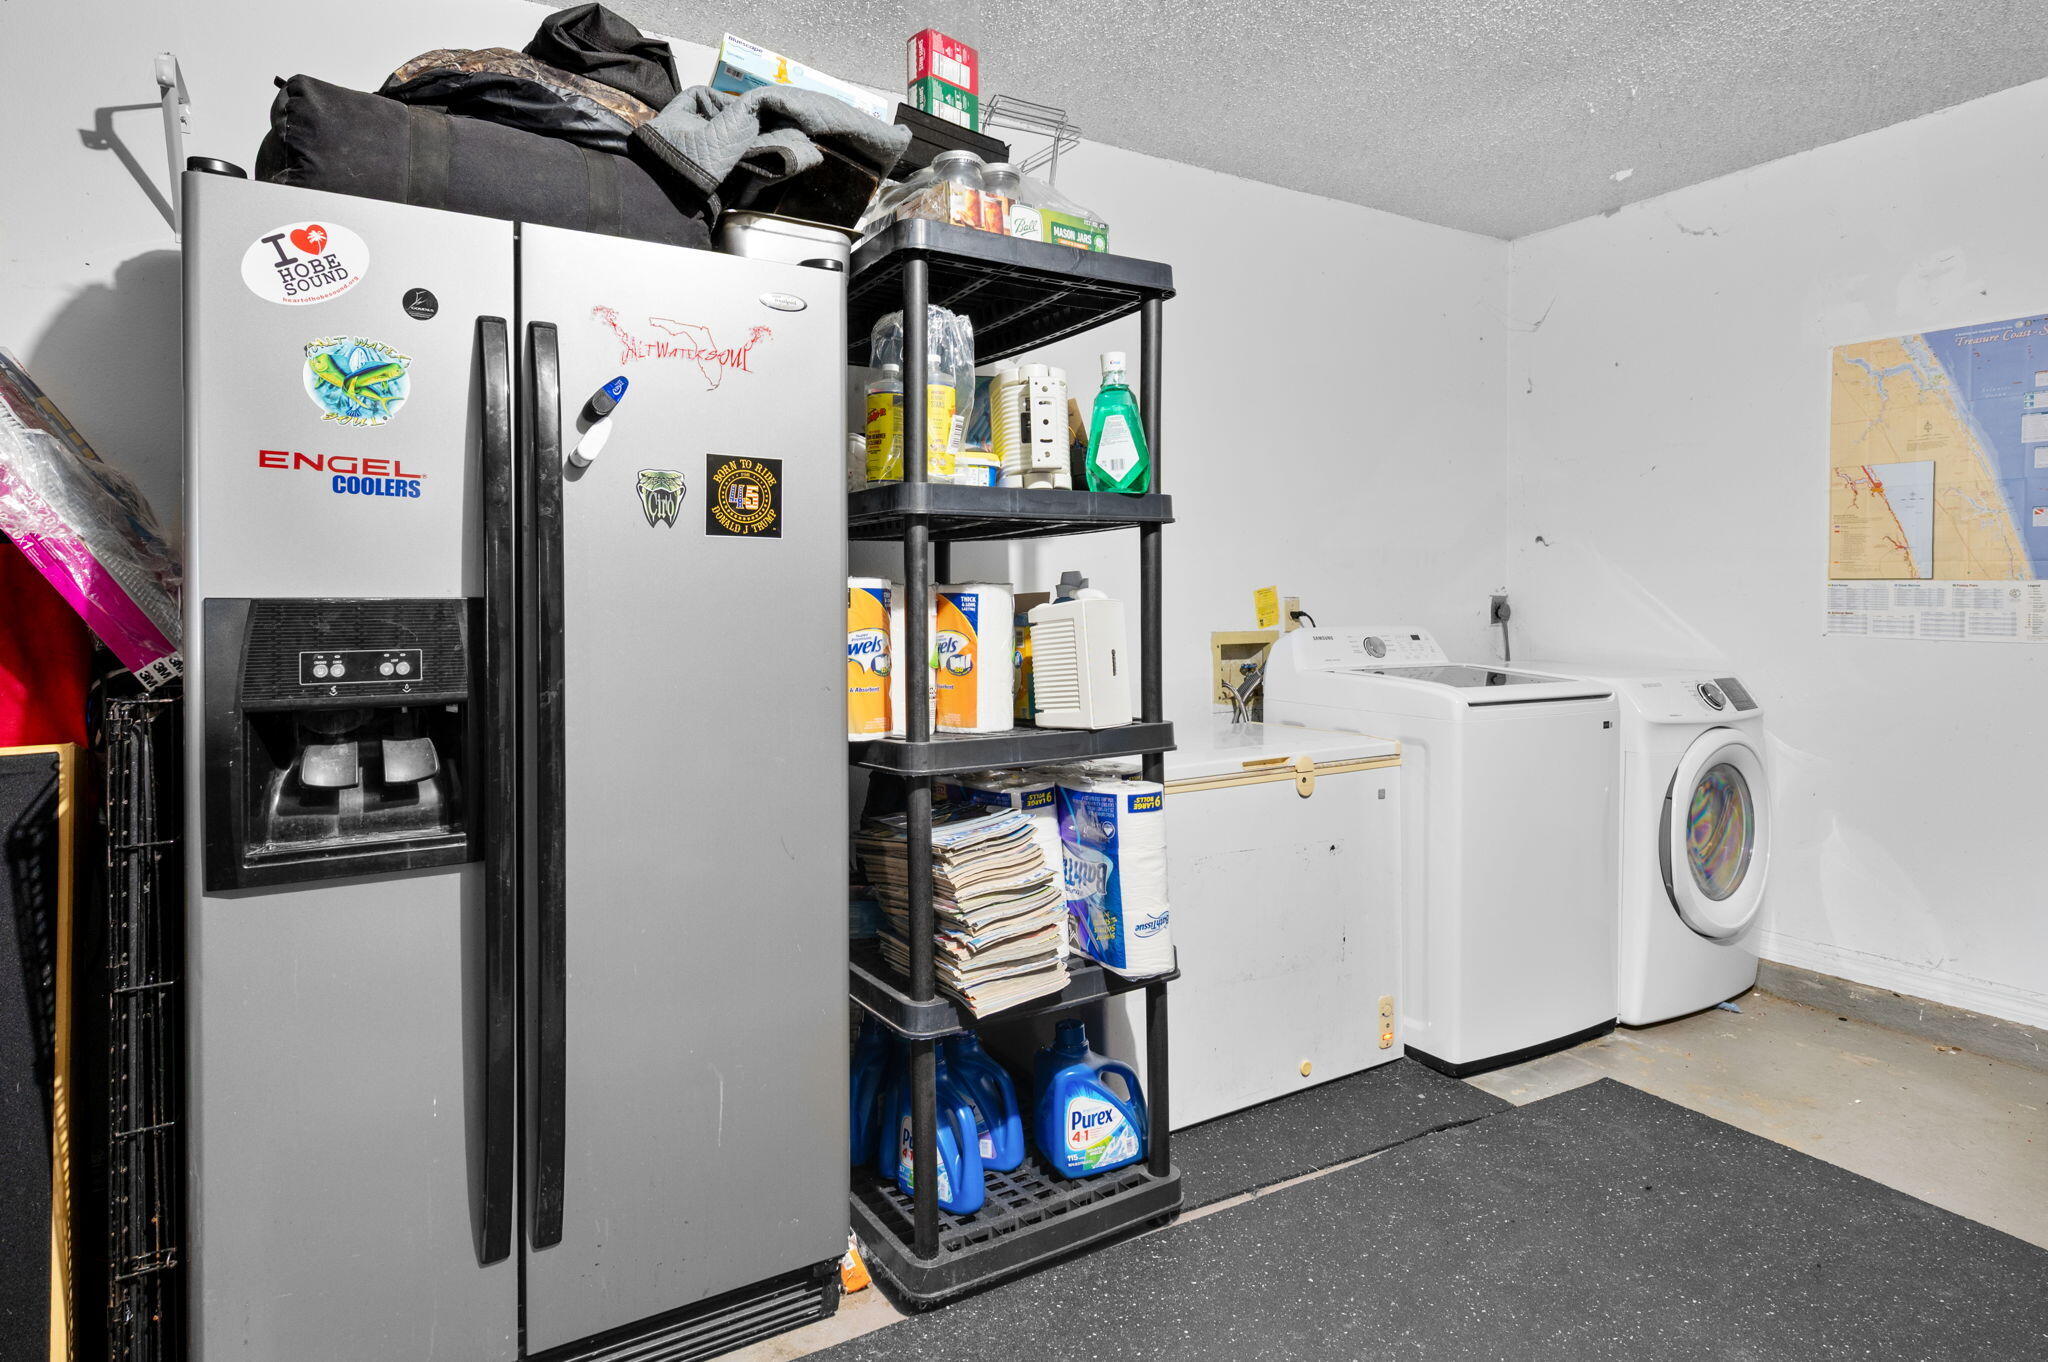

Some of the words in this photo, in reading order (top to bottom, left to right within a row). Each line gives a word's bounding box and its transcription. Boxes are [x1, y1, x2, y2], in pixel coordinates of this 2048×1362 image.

[1014, 218, 1038, 236] Ball
[1053, 226, 1076, 241] MASON
[1077, 232, 1092, 245] JARS
[261, 233, 298, 268] I
[277, 254, 342, 283] HOBE
[284, 267, 349, 296] SOUND
[1955, 334, 1999, 346] Treasure
[713, 460, 737, 484] BORN
[740, 459, 752, 469] TO
[754, 462, 777, 487] RIDE
[332, 475, 421, 498] COOLERS
[729, 483, 760, 511] 45
[712, 505, 741, 533] DONALD
[743, 525, 749, 535] J
[751, 508, 777, 533] TRUMP
[848, 635, 883, 656] wels
[140, 670, 158, 688] 3M
[153, 661, 172, 679] 3M
[1045, 791, 1053, 802] 9
[1133, 802, 1155, 810] LARGE
[1155, 796, 1161, 808] 9
[1072, 1108, 1113, 1131] Purex
